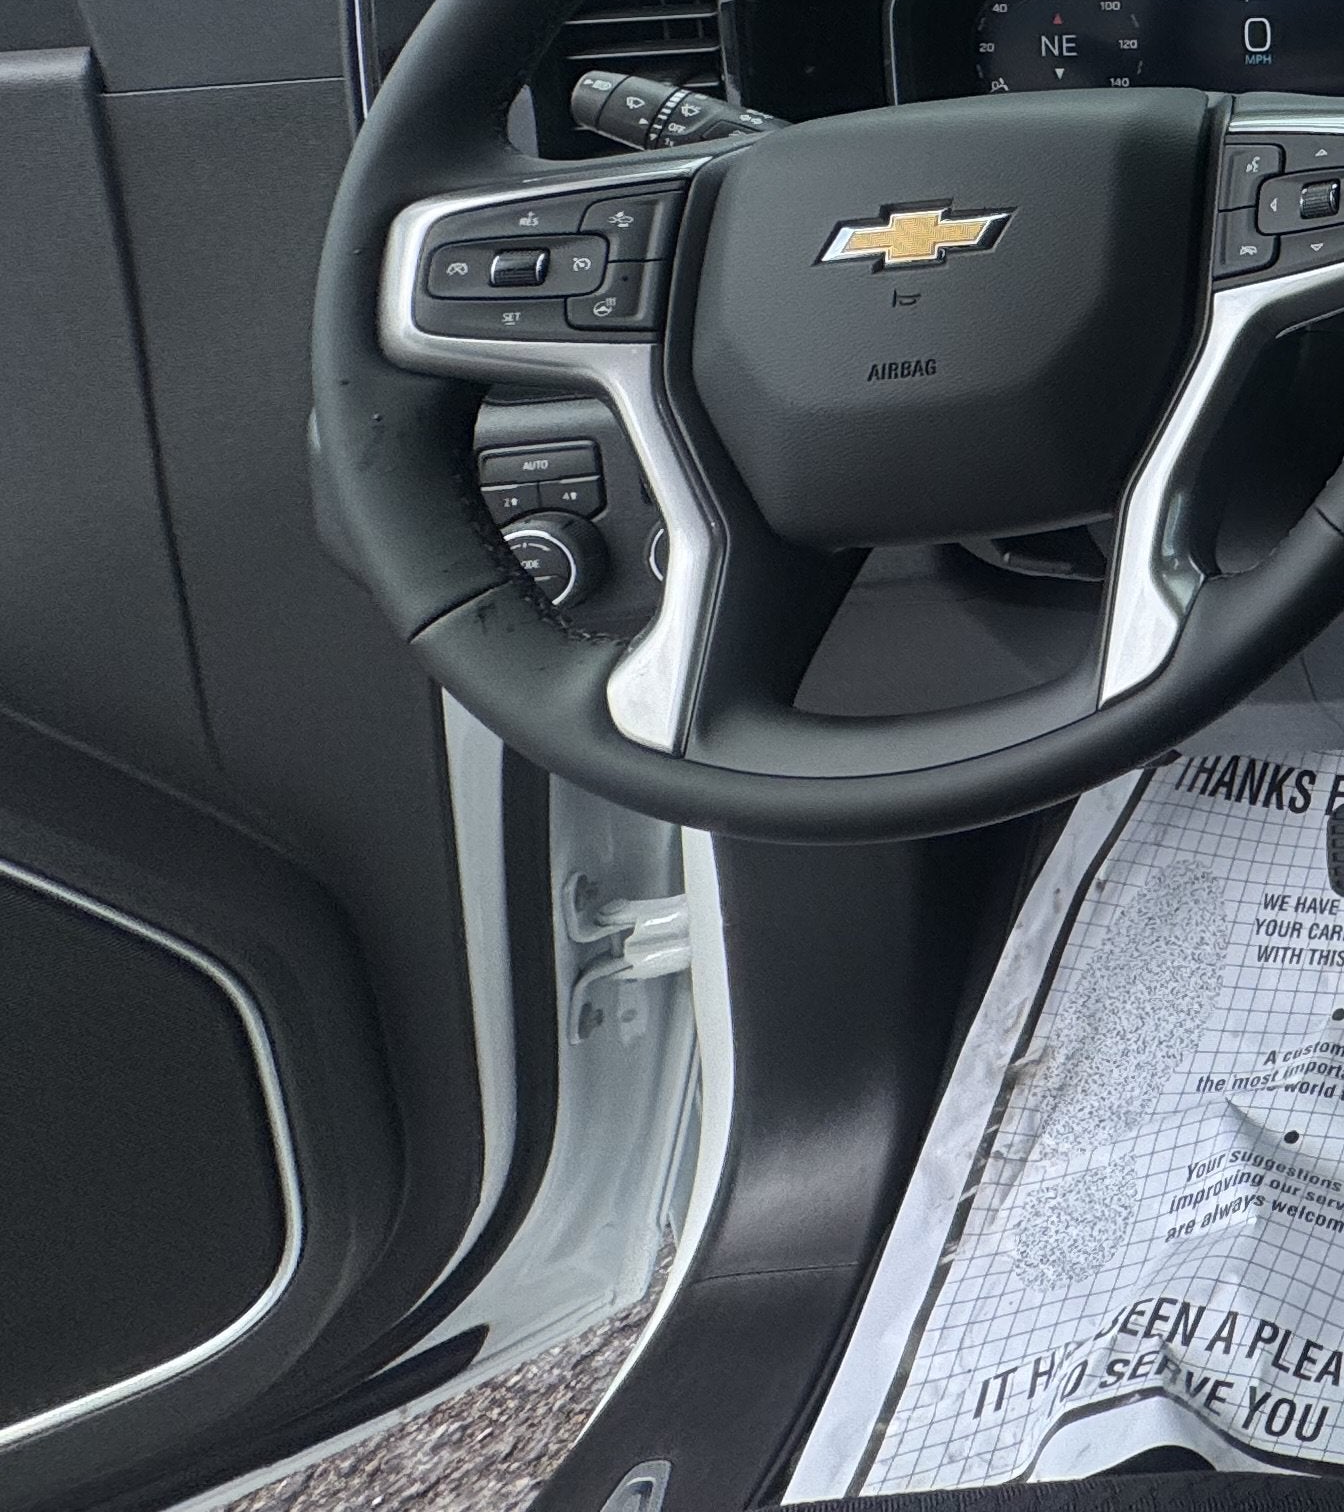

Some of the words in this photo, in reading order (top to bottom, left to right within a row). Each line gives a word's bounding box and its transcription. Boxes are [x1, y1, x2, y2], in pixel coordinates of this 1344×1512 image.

[992, 3, 1008, 13] 40
[1100, 1, 1121, 11] 100
[1118, 39, 1138, 49] 120
[1244, 17, 1271, 52] 0
[979, 43, 995, 52] 20
[1041, 34, 1078, 57] NE
[1244, 54, 1272, 65] MPH
[1109, 77, 1130, 87] 140
[668, 122, 686, 134] OFF
[519, 215, 539, 226] RES
[502, 312, 521, 322] SET
[867, 359, 936, 382] AIRBAG
[522, 460, 548, 470] AUTO
[519, 560, 540, 569] ODE
[1175, 754, 1317, 814] THANKS
[1264, 894, 1291, 912] WE
[1294, 896, 1340, 915] HAVE
[1255, 918, 1303, 939] YOUR
[1257, 945, 1302, 965] WITH
[1264, 1050, 1277, 1066] A
[1196, 1076, 1226, 1093] the
[1232, 1070, 1278, 1090] most
[1284, 1081, 1337, 1099] world
[1186, 1154, 1225, 1182] Your
[1229, 1150, 1343, 1192] suggestions
[1169, 1169, 1265, 1214] improving
[1269, 1178, 1300, 1196] our
[1165, 1218, 1196, 1243] are
[1200, 1192, 1266, 1229] always
[973, 1366, 1019, 1420] IT
[1205, 1310, 1239, 1355] A
[1099, 1350, 1234, 1416] SERVE
[1242, 1385, 1329, 1443] YOU
